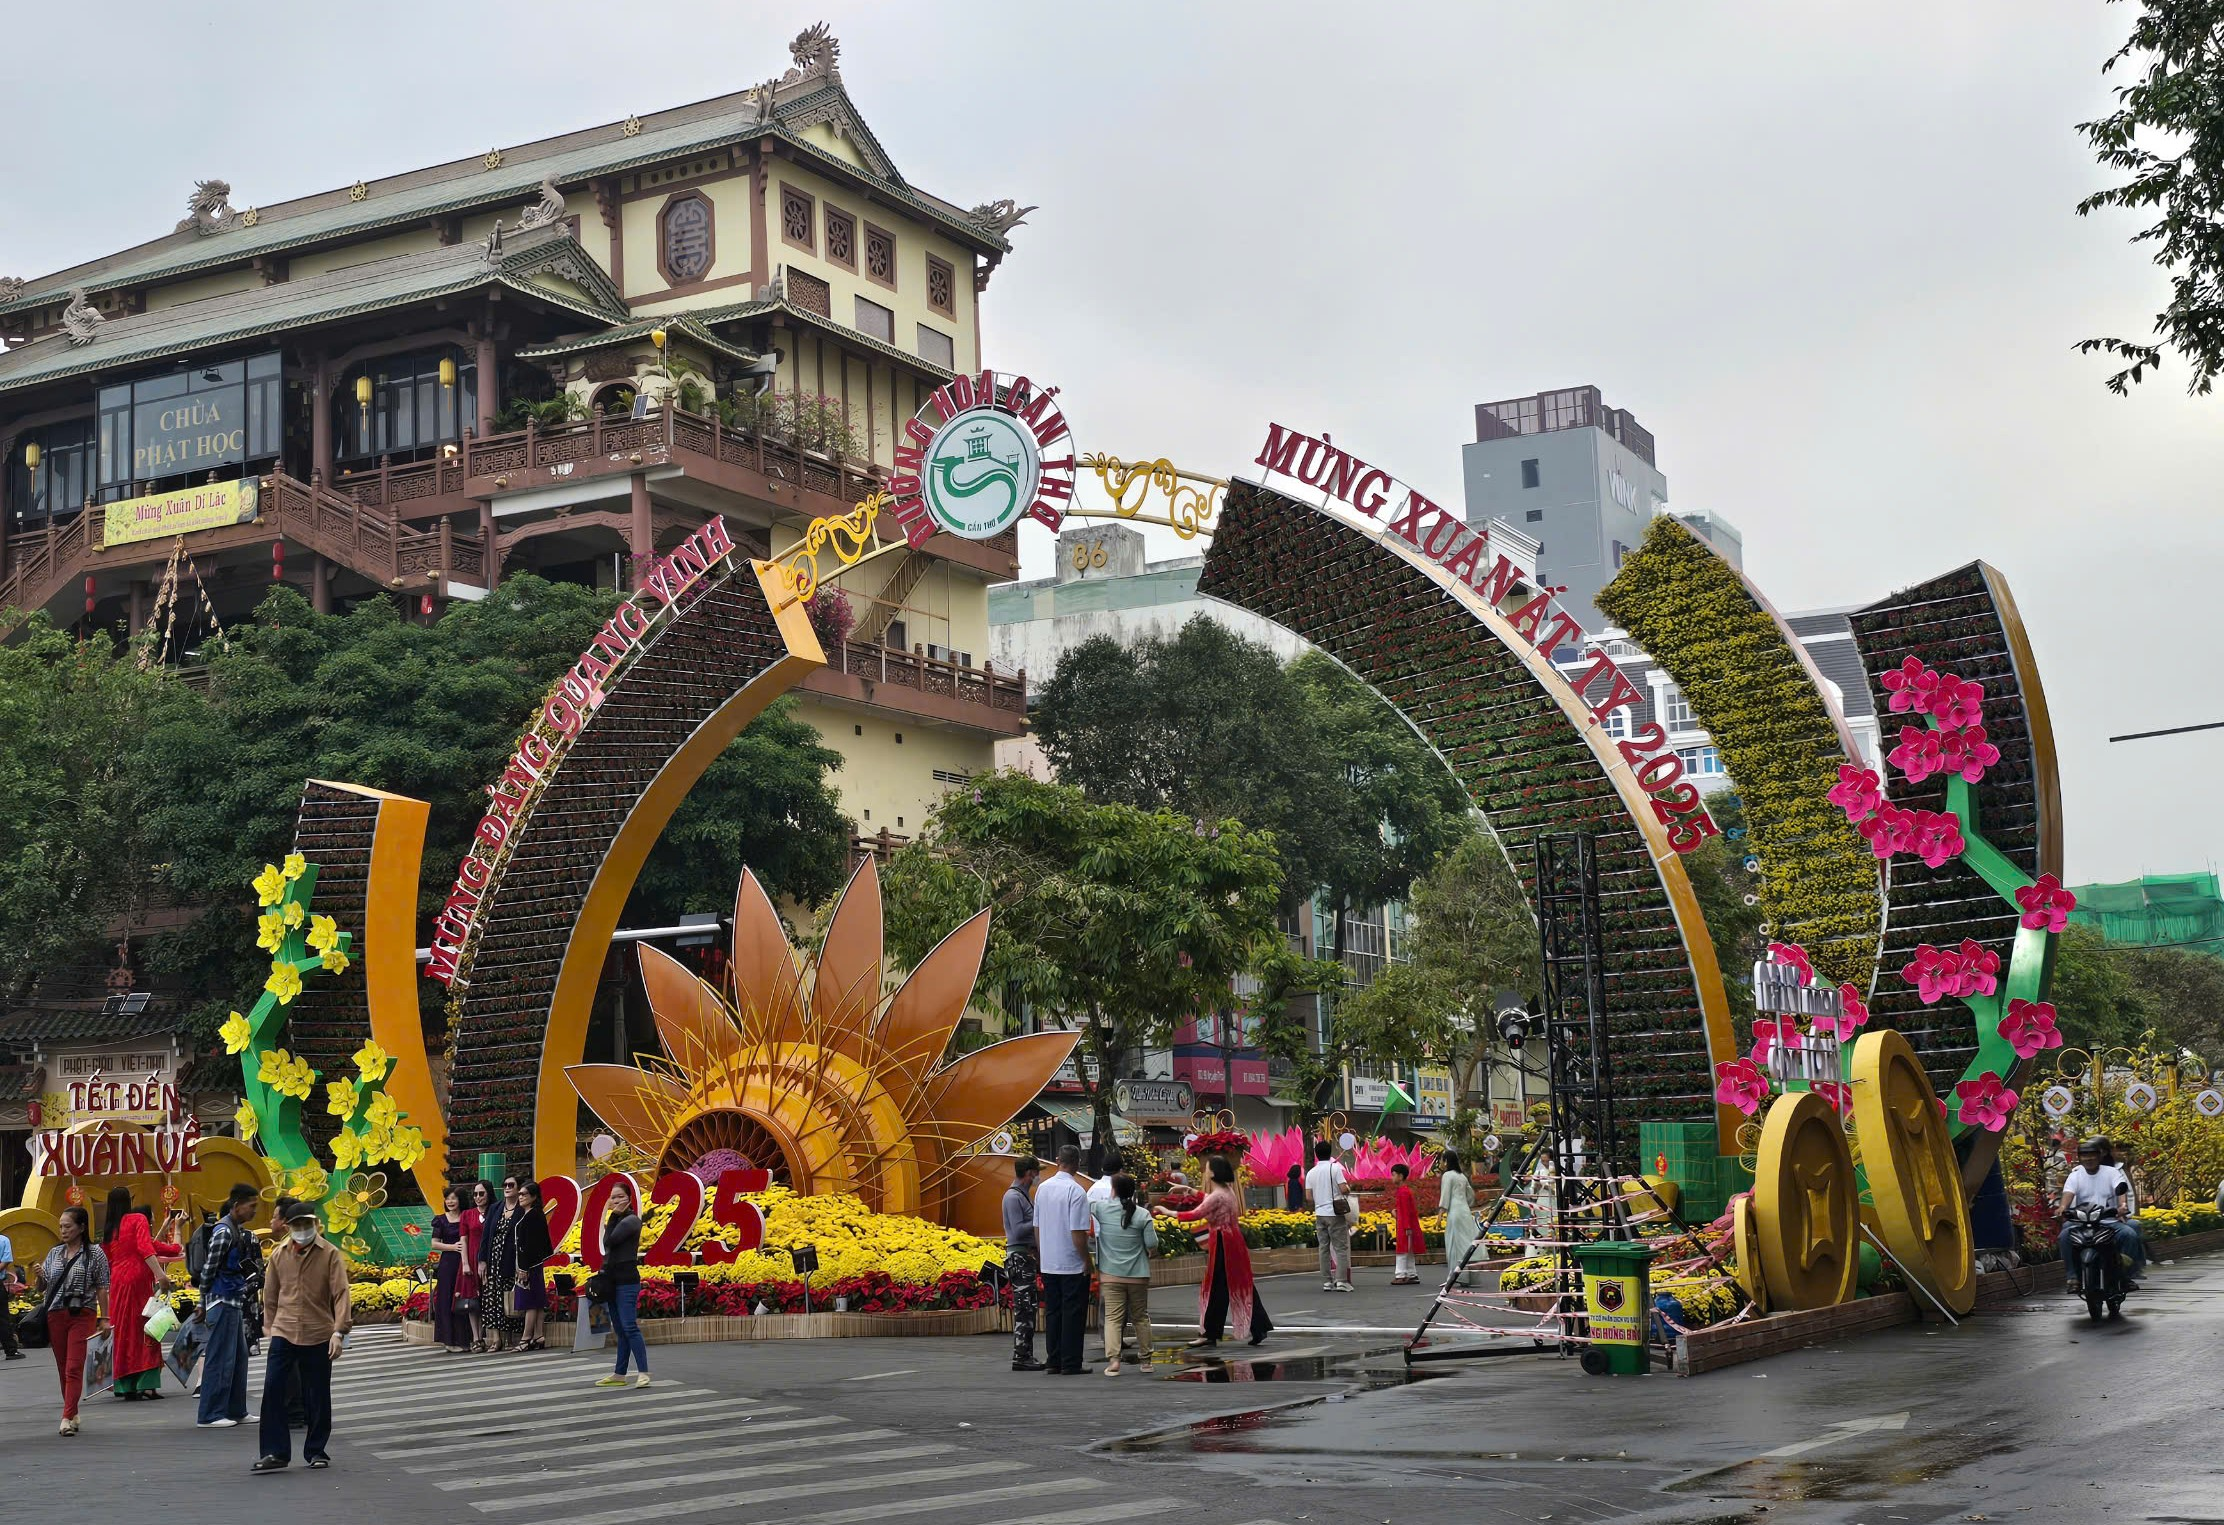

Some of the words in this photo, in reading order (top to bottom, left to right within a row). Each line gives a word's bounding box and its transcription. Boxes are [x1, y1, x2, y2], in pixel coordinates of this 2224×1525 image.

[160, 399, 221, 431] CHÙA
[135, 440, 191, 469] PHẬT
[196, 429, 244, 458] HỌC
[929, 369, 994, 423] HOA
[1030, 454, 1074, 534] THƠ
[136, 504, 162, 522] Mừng
[166, 498, 191, 516] Xuân
[1607, 469, 1638, 516] WINK
[1072, 538, 1108, 570] 86
[1254, 422, 1392, 518] MỪNG
[1389, 489, 1525, 607] XUÂN
[1506, 585, 1582, 660] ẤT
[1570, 648, 1645, 725] TỴ
[1616, 722, 1720, 854] 2025
[474, 732, 553, 853] ĐẢNG
[544, 601, 650, 739] QUANG
[641, 514, 735, 604] VINH
[67, 1068, 120, 1111] TẾT
[125, 1070, 180, 1111] ĐẾN
[37, 1120, 145, 1176] XUÂN
[154, 1114, 202, 1174] VỀ
[538, 1169, 773, 1273] 2025
